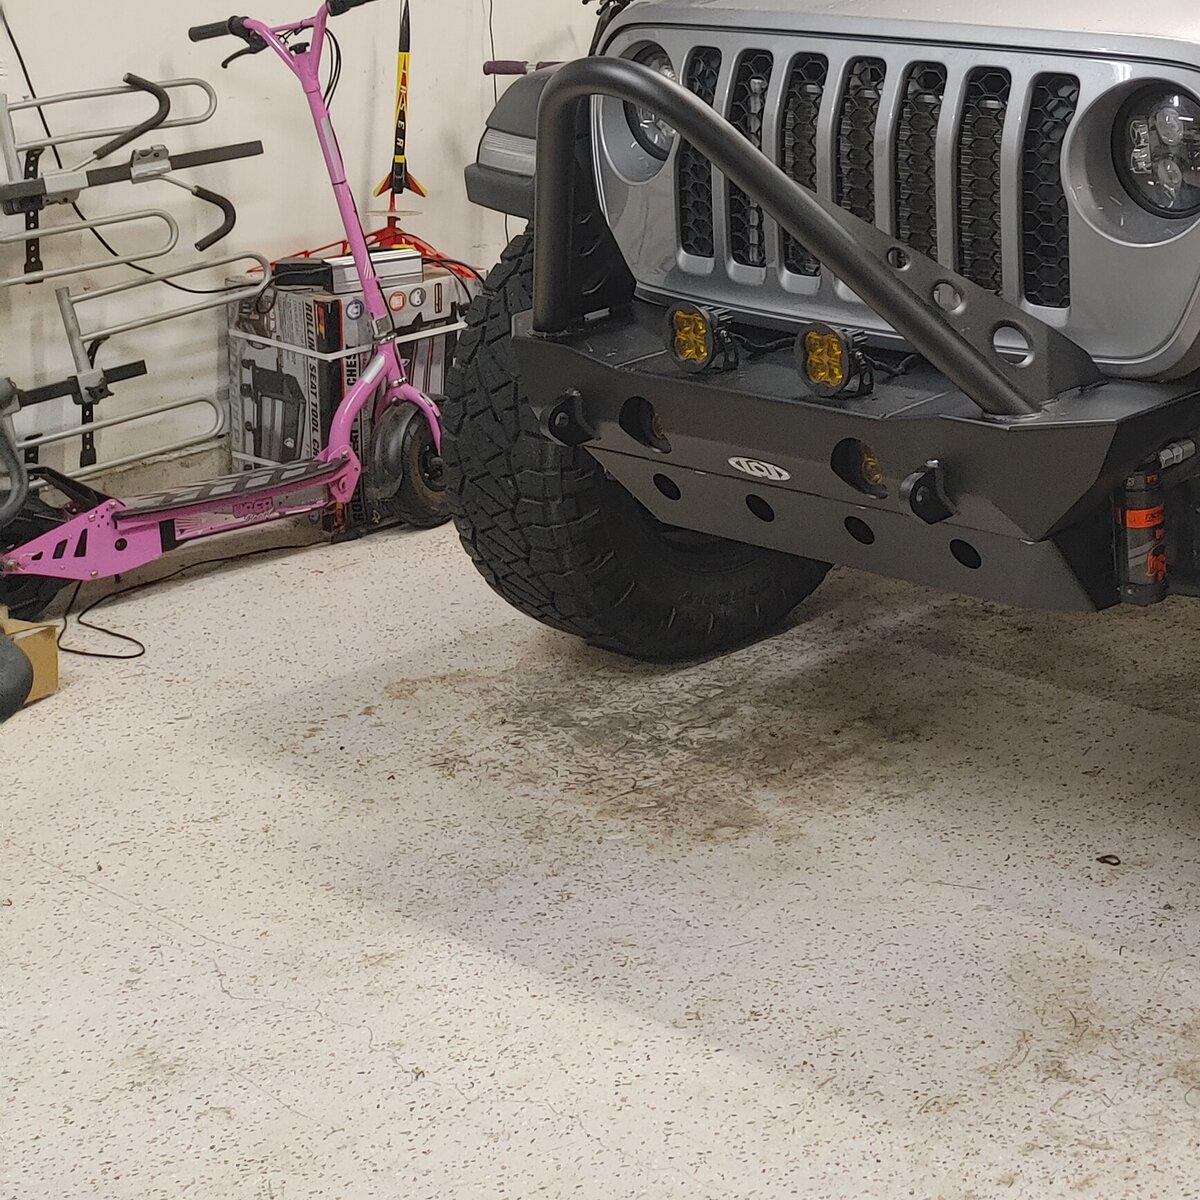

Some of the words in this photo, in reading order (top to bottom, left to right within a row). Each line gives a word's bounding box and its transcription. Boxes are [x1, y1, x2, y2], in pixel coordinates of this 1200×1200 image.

[305, 302, 317, 358] ROLLIN
[309, 363, 317, 399] SEAT
[311, 401, 319, 433] TOOL
